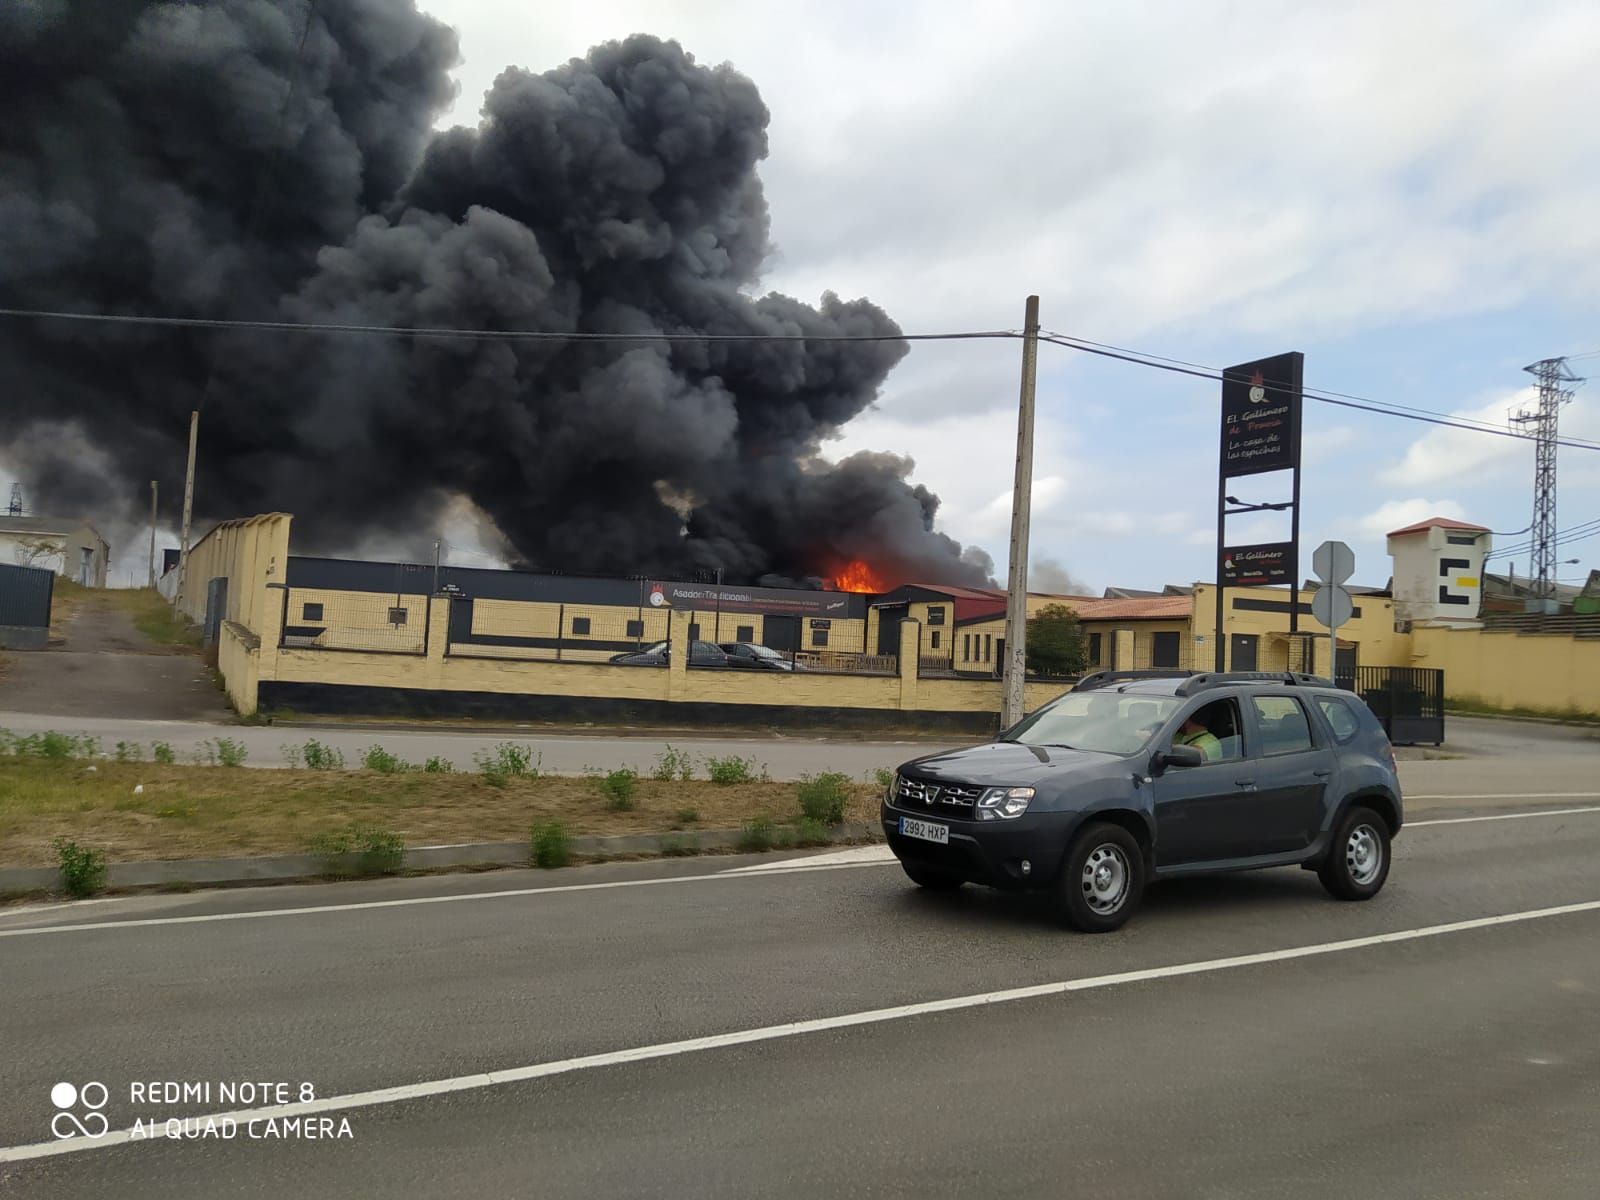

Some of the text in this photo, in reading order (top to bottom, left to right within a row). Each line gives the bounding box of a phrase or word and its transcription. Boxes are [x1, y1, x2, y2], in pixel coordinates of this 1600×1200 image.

[1241, 406, 1289, 421] Gallinero
[1246, 551, 1283, 561] Gallinero
[904, 820, 946, 840] 2992 HXP
